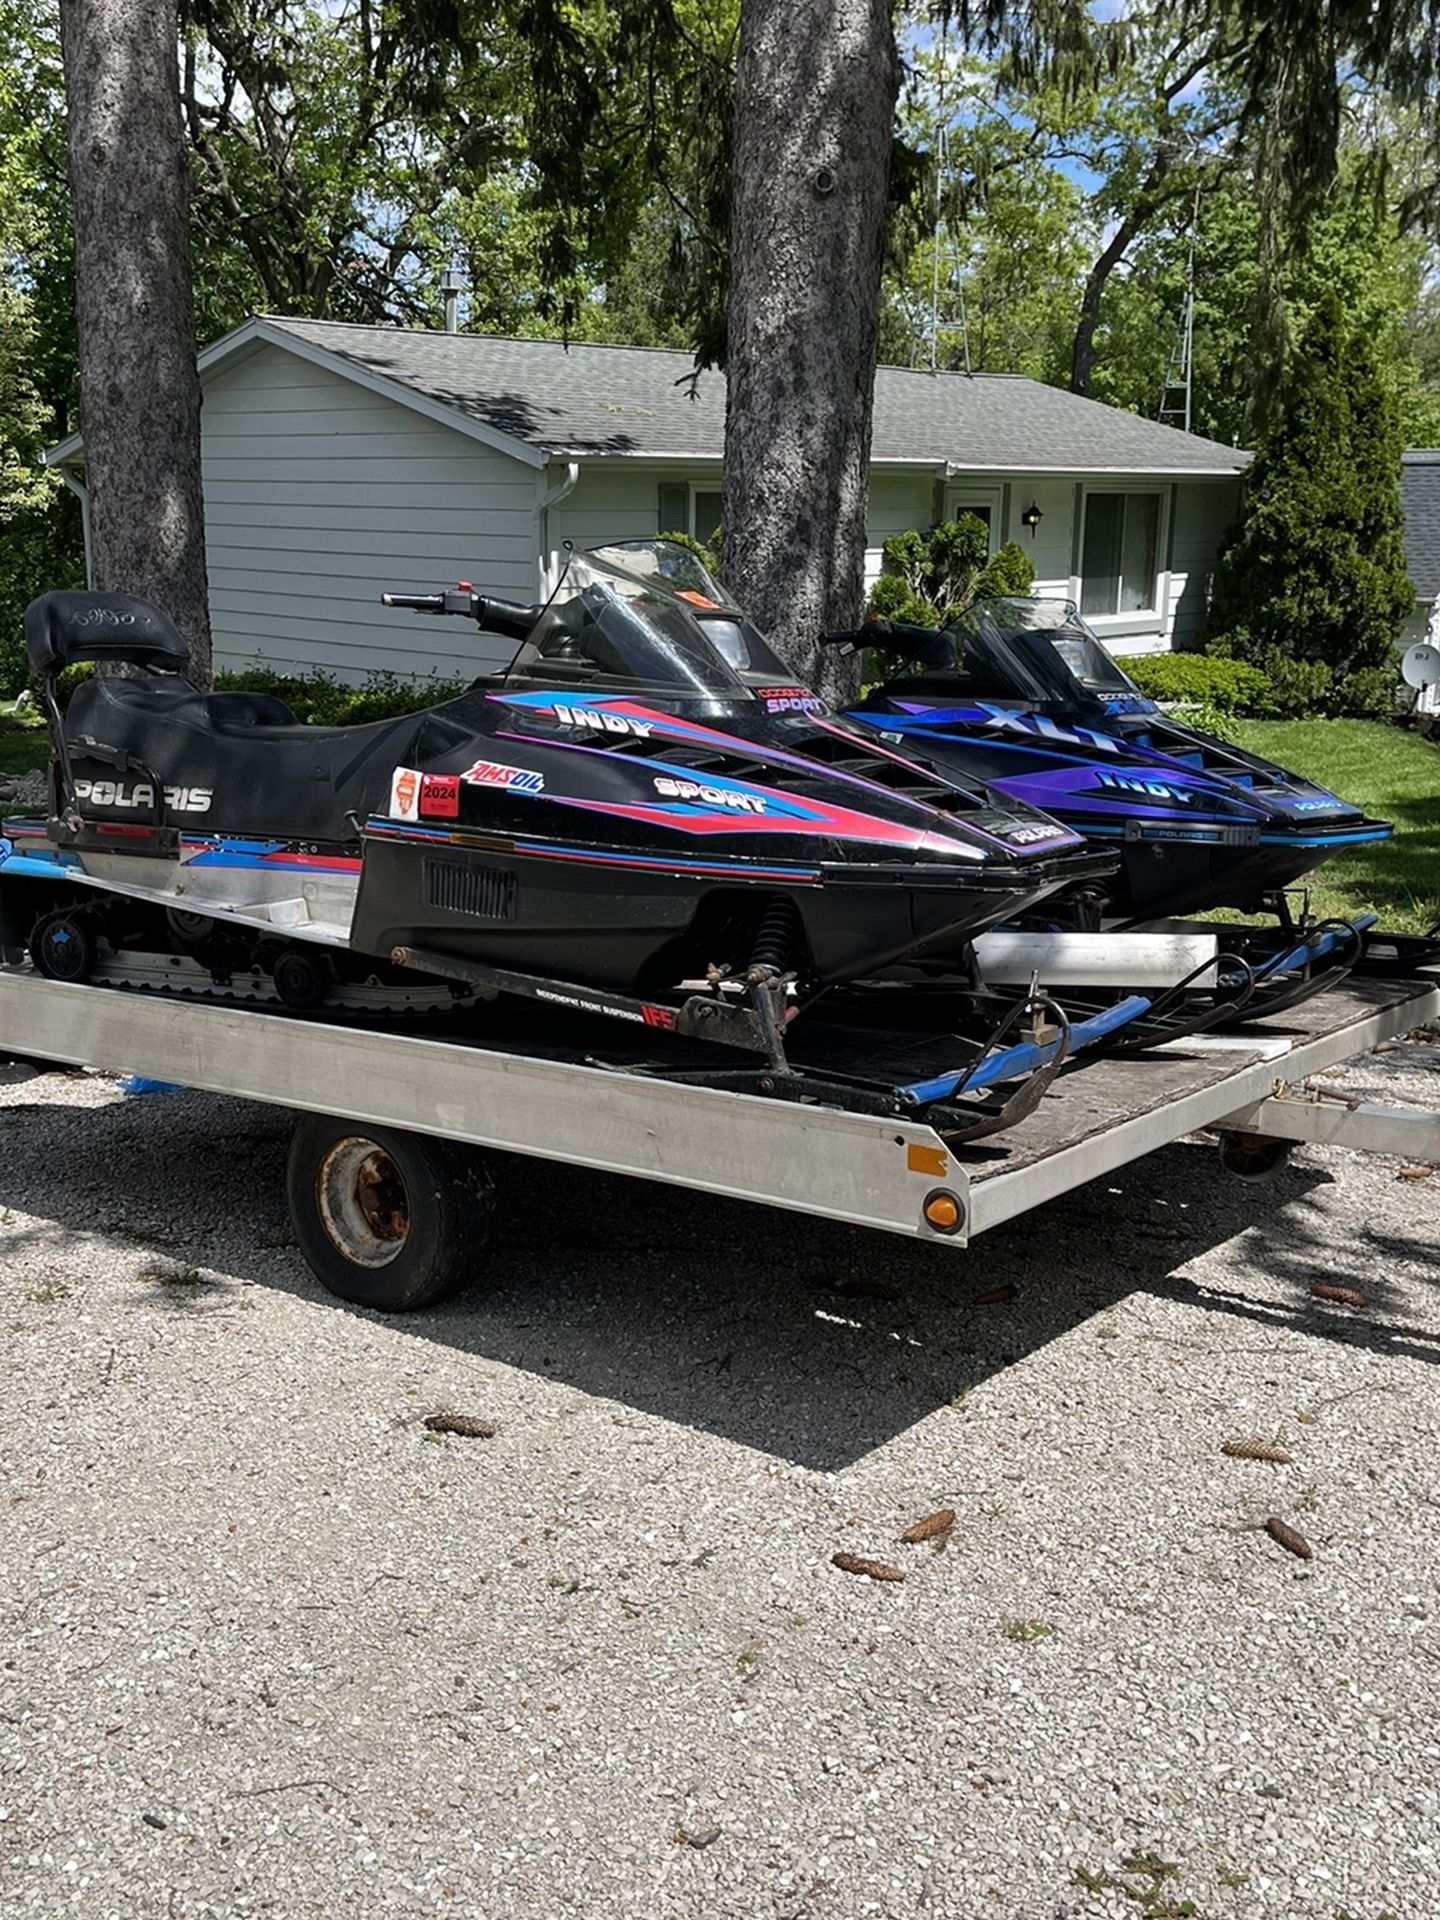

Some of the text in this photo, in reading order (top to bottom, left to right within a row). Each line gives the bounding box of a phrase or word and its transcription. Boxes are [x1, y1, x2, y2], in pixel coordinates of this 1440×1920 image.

[552, 703, 654, 738] INDY
[766, 698, 820, 713] SPORT
[974, 701, 1123, 753] XLT
[466, 762, 543, 790] AMSOIL
[1096, 772, 1194, 803] INDY
[73, 779, 214, 812] POLARIS
[424, 785, 456, 800] 2024
[653, 777, 768, 813] SPORT
[640, 1004, 675, 1029] IFS
